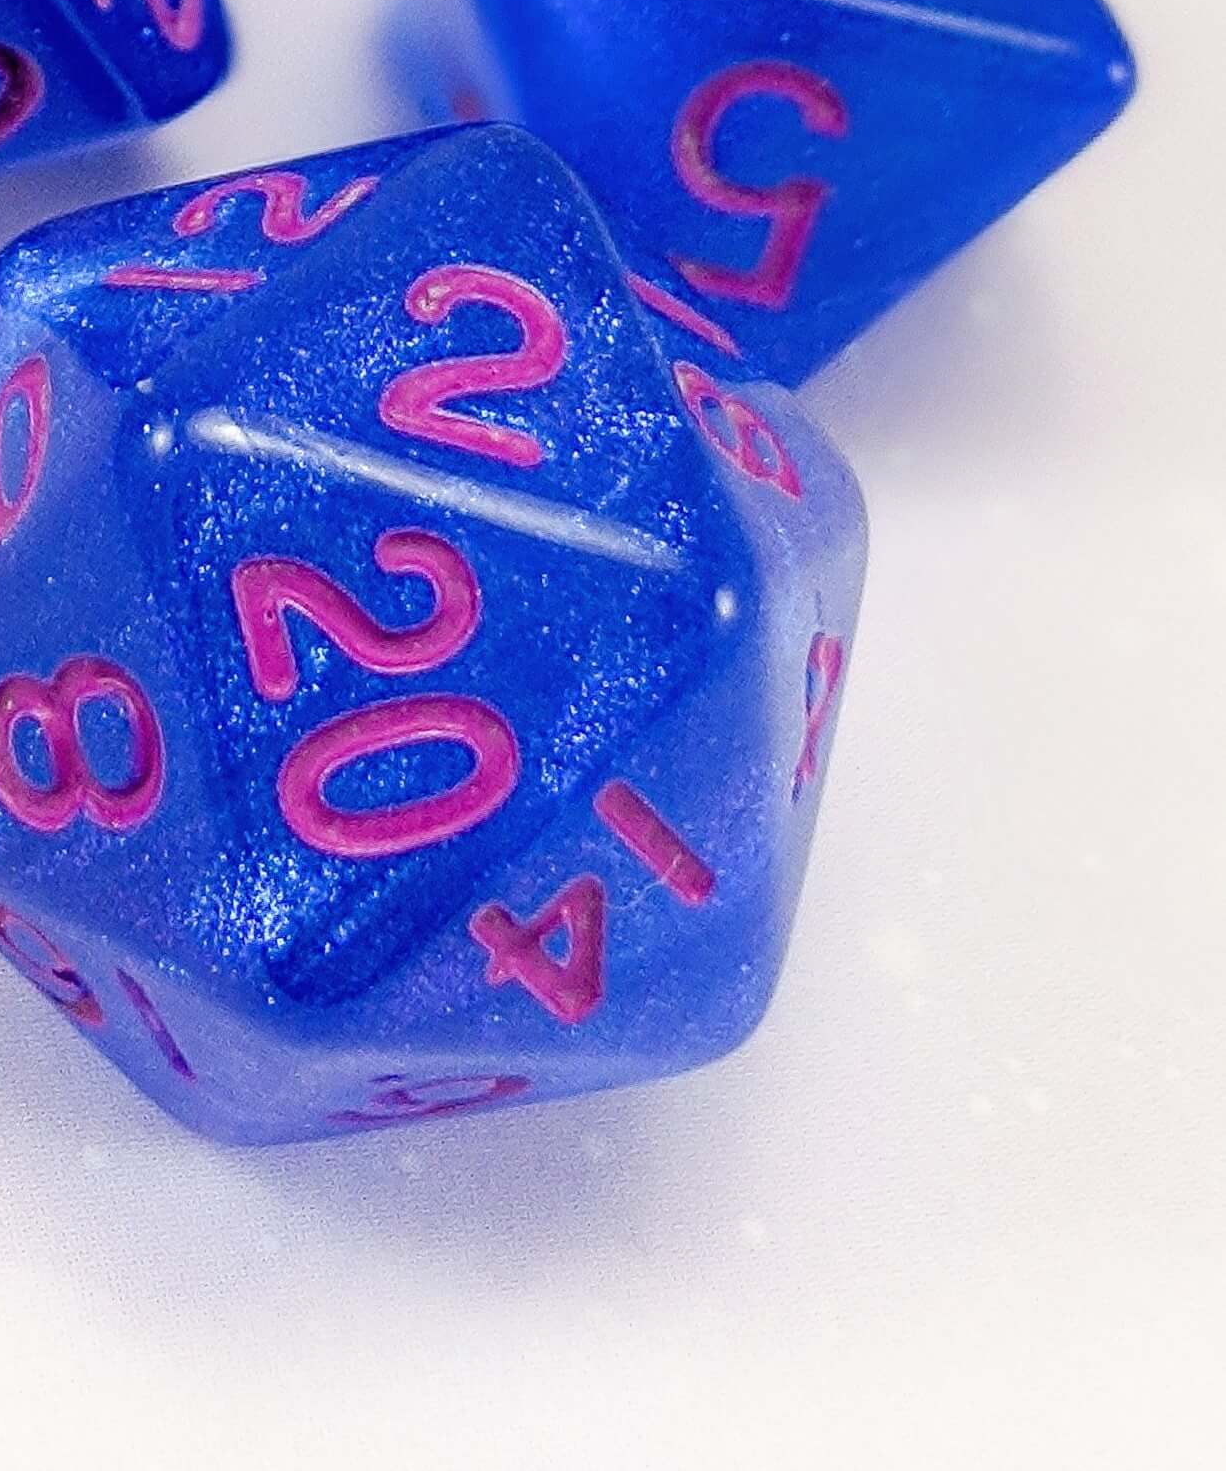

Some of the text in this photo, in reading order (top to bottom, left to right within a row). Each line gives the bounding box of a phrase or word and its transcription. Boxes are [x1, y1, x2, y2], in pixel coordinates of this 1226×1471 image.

[98, 170, 380, 295] 12
[668, 58, 851, 312] 5
[378, 262, 570, 469] 2
[230, 527, 521, 861] 20
[468, 778, 718, 1026] 14
